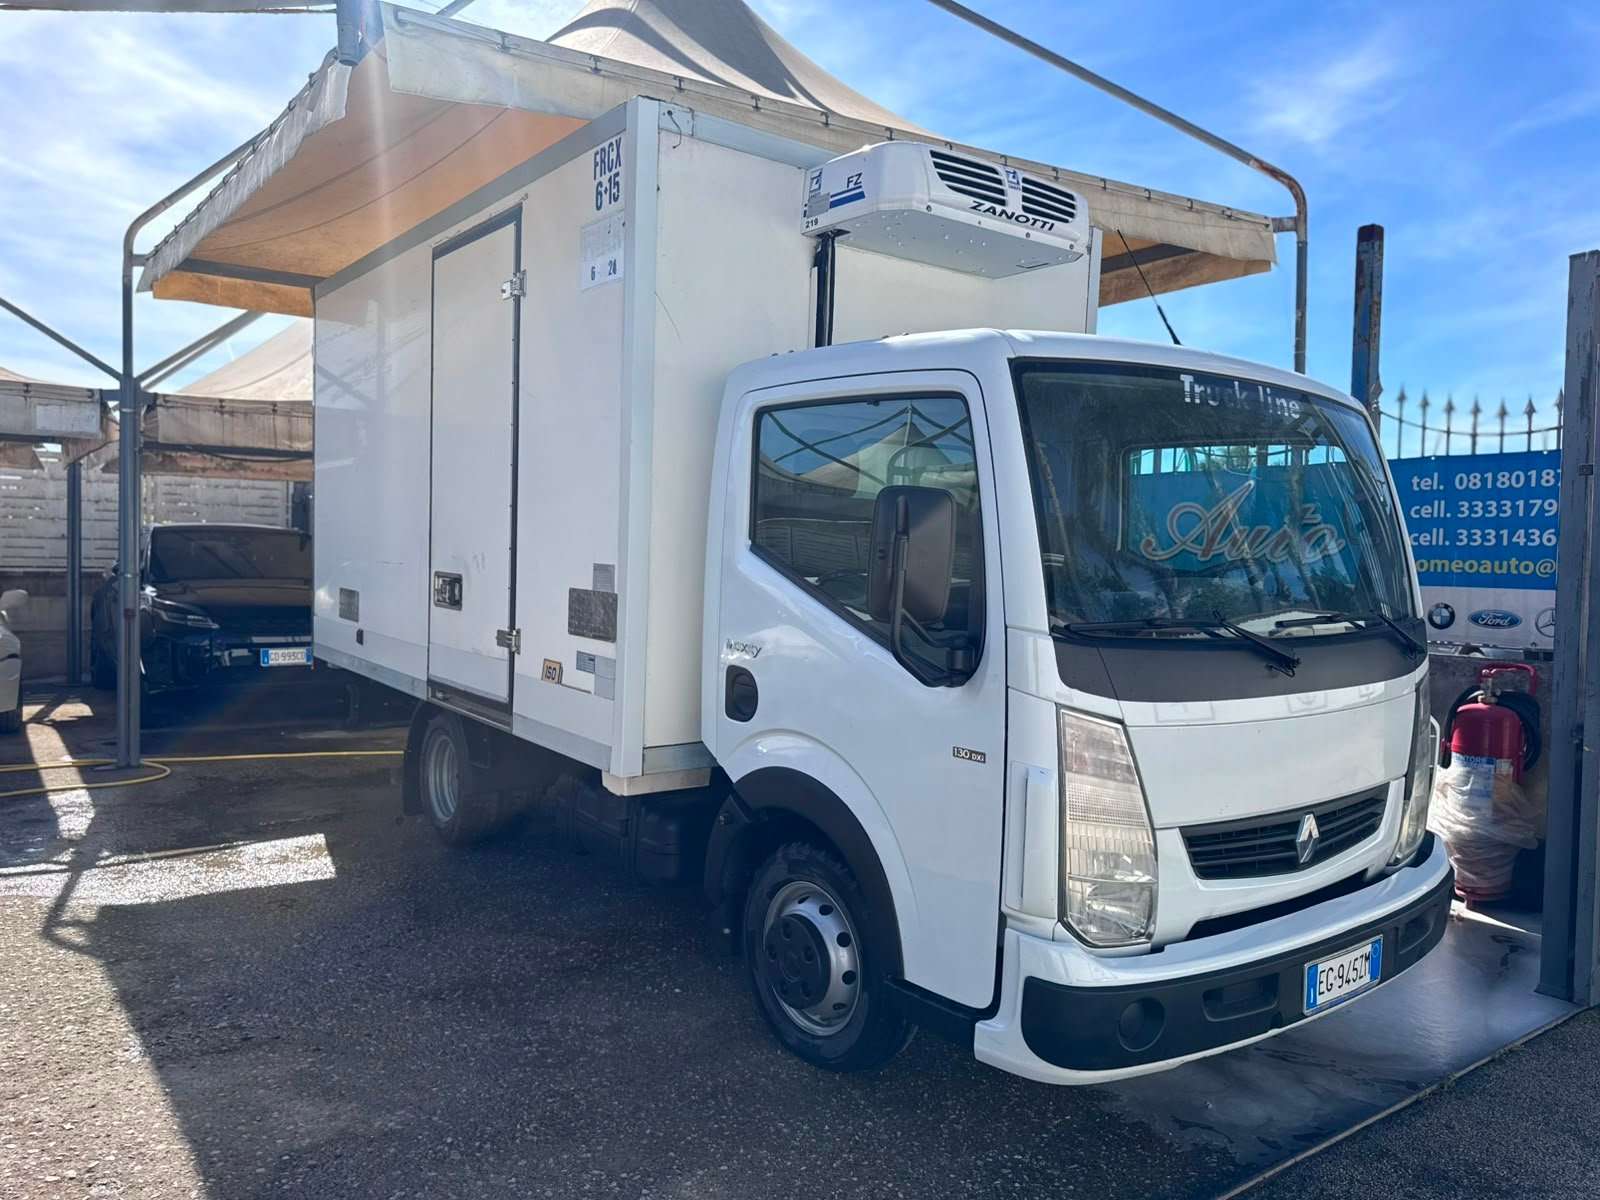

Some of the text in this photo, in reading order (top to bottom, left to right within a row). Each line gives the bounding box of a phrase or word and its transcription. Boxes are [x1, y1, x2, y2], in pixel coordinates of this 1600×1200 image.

[593, 136, 622, 181] FRCX
[846, 171, 864, 190] FZ
[969, 200, 1055, 232] ZANOTTI
[1257, 385, 1301, 420] line
[1411, 472, 1445, 491] tel.
[1410, 499, 1558, 518] cell. 3333179
[1410, 528, 1557, 547] cell. 3331436
[1477, 612, 1512, 627] Ford
[544, 665, 557, 681] ISO
